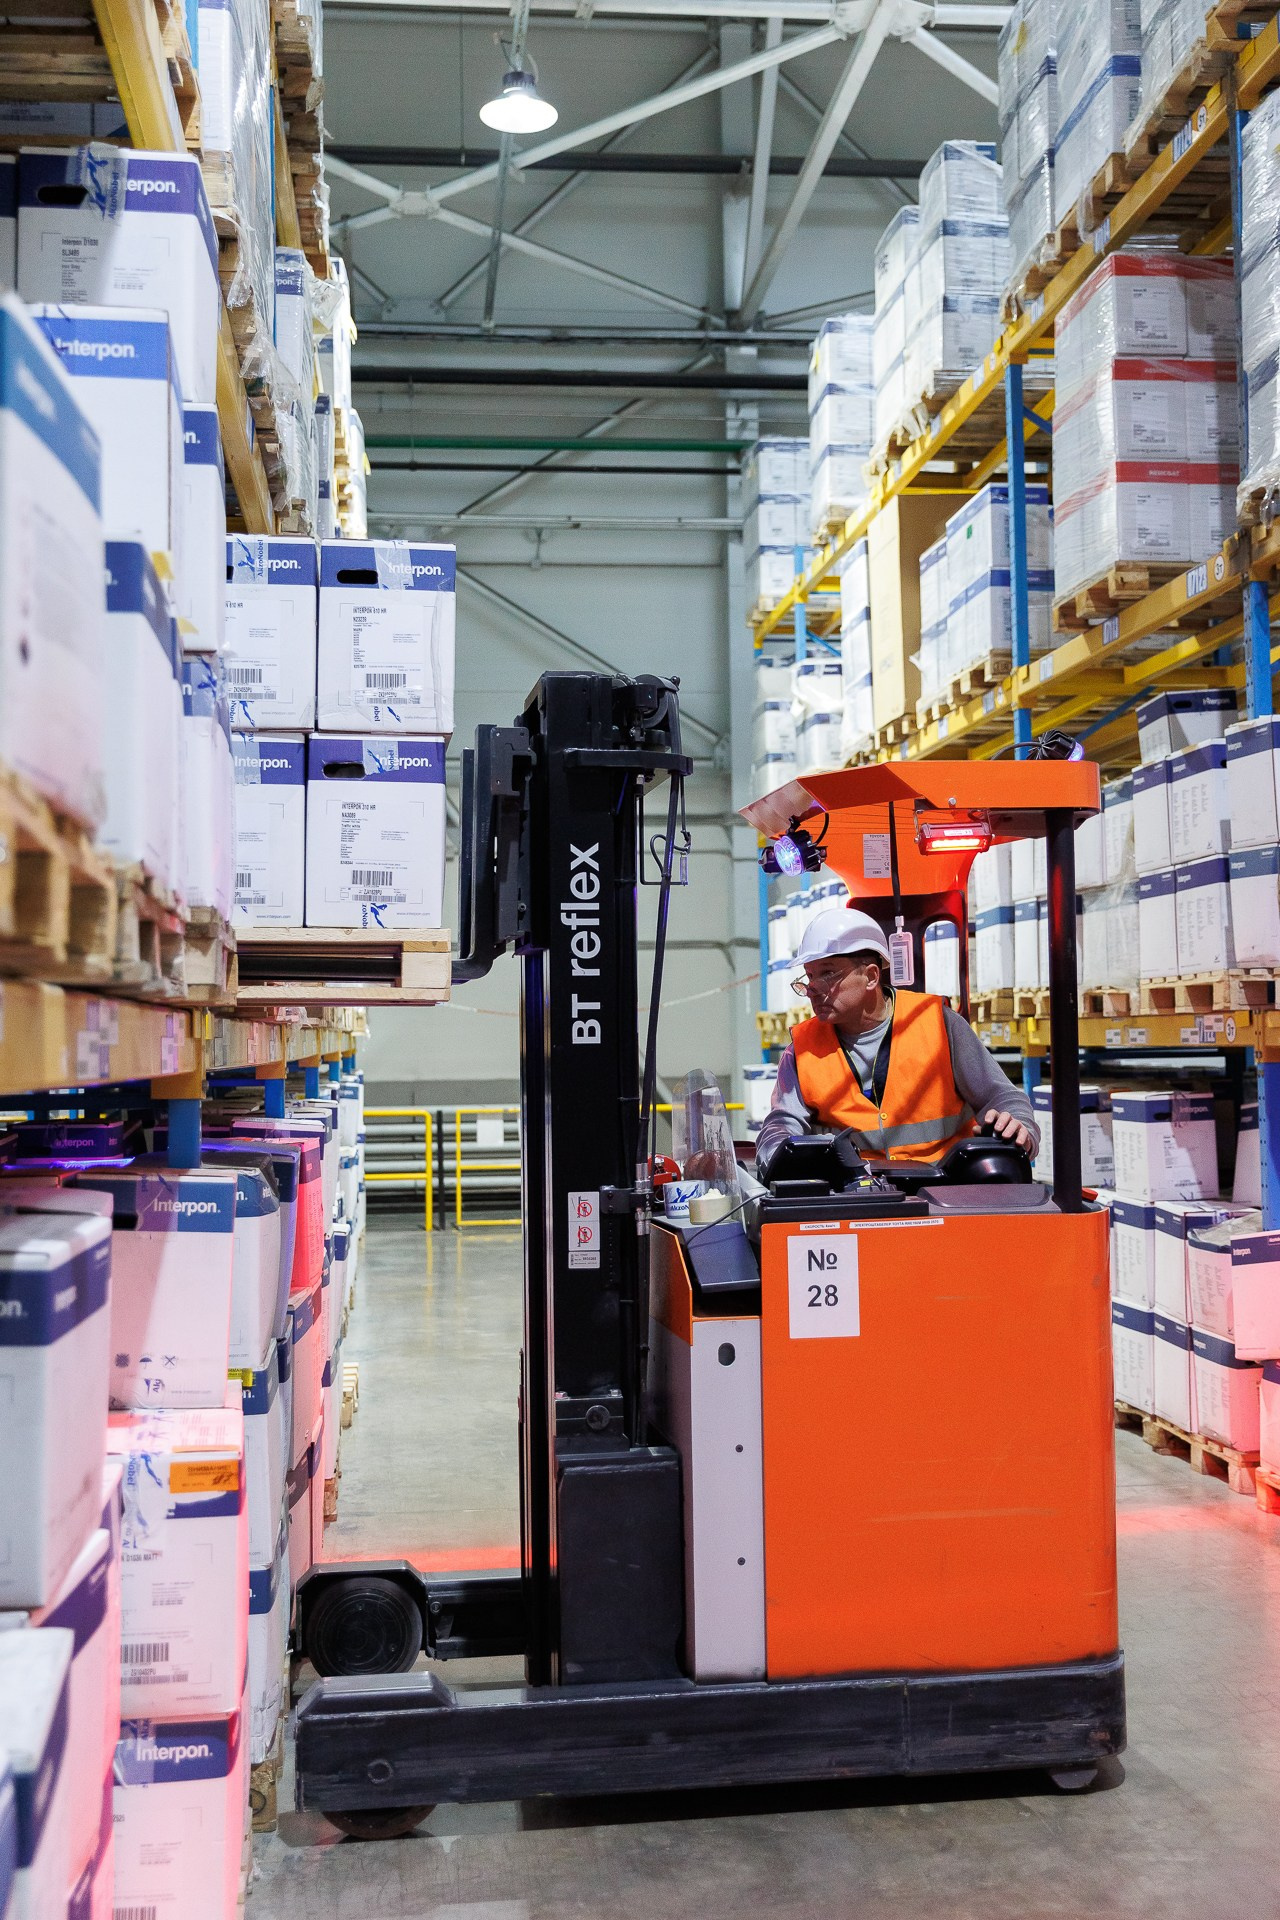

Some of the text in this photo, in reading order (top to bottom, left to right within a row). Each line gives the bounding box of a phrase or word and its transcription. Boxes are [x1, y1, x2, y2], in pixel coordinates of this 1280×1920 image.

[388, 562, 445, 577] Interpon.
[234, 755, 292, 771] Interpon.
[377, 755, 433, 772] Interpon.
[560, 842, 601, 1044] BT reflex
[153, 1199, 222, 1217] Interpon.
[807, 1284, 839, 1308] 28
[136, 1742, 213, 1763] Interpon.
